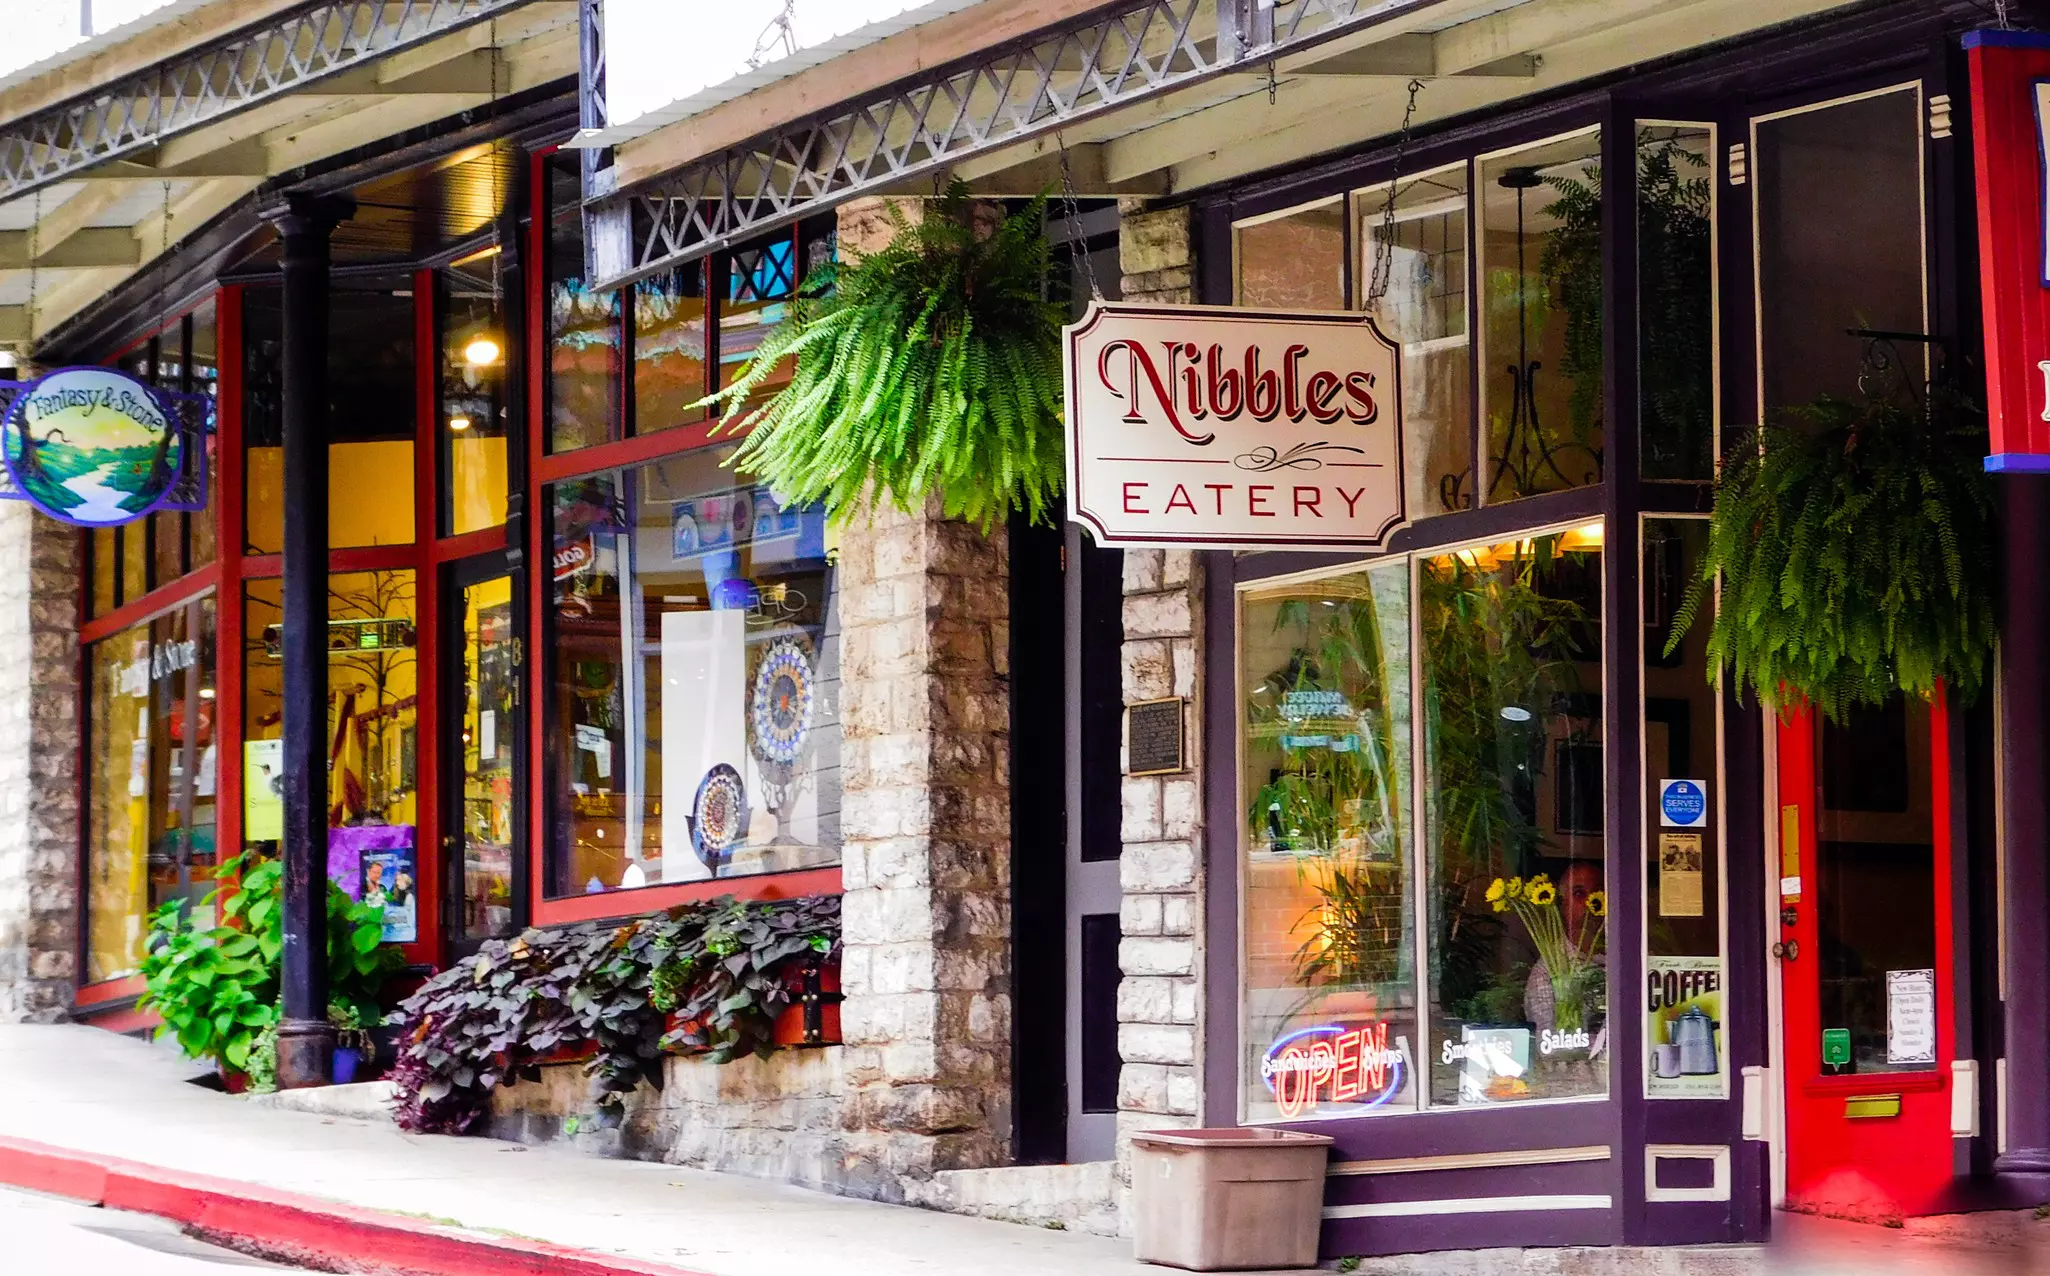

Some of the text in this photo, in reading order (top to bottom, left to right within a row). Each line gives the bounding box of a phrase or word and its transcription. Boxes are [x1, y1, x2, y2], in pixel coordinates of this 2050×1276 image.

[33, 386, 163, 433] Fantasy & Stone
[1097, 338, 1380, 446] Nibbles
[1122, 481, 1367, 519] EATERY
[1665, 799, 1701, 808] SERVES
[1540, 1028, 1590, 1055] Salads
[1261, 1046, 1404, 1078] Sandwiches Soups
[1275, 1020, 1389, 1119] OPEN
